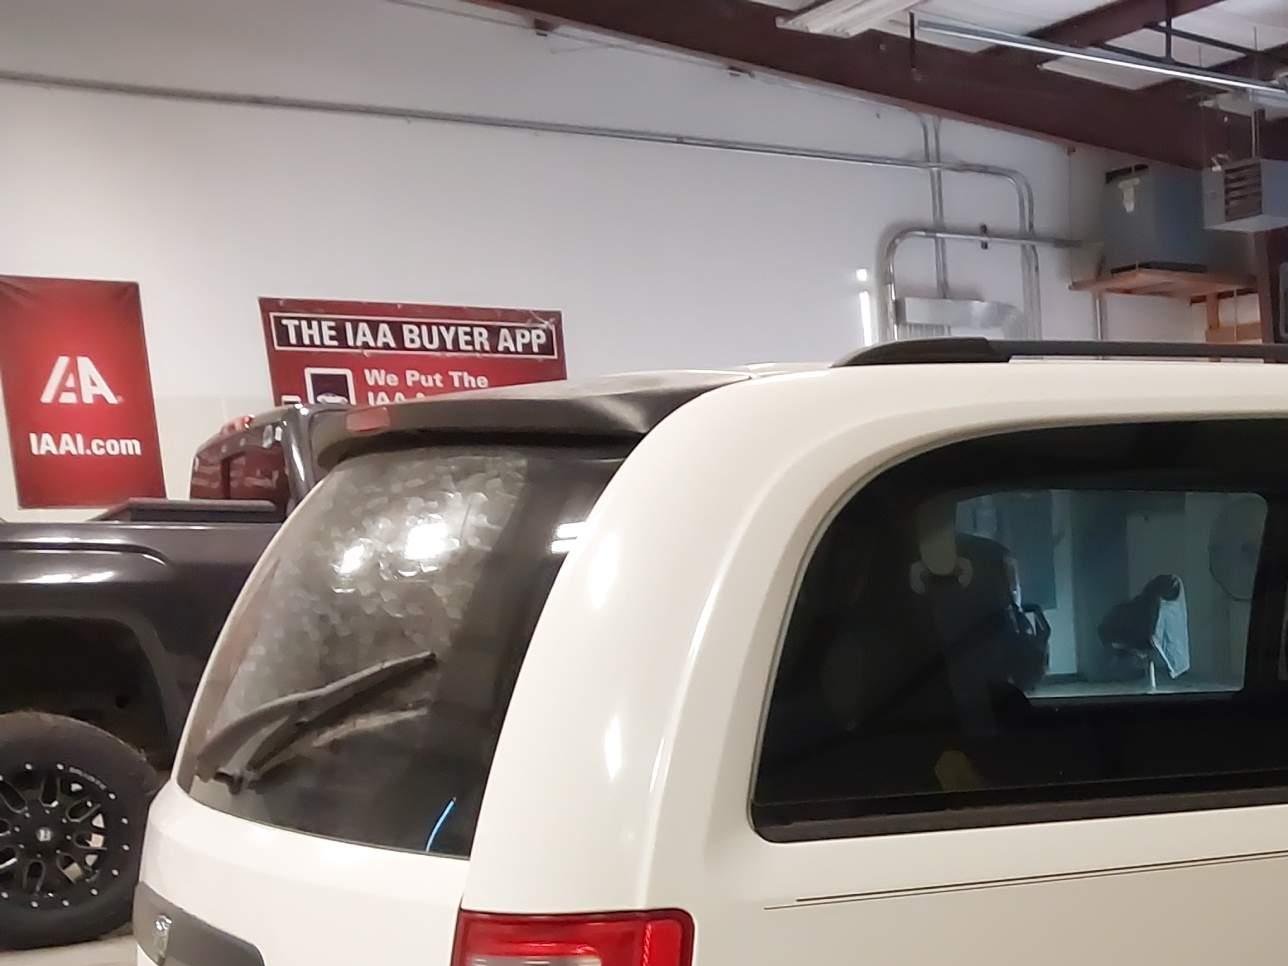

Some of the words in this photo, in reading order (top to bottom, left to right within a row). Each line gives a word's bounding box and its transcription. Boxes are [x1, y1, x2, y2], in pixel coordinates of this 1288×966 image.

[281, 319, 339, 346] THE
[344, 321, 397, 348] IAA
[402, 323, 491, 351] BUYER
[497, 327, 547, 353] APP
[364, 368, 399, 386] We
[405, 369, 444, 388] Put
[448, 370, 489, 388] The
[29, 432, 142, 456] IAAI.com
